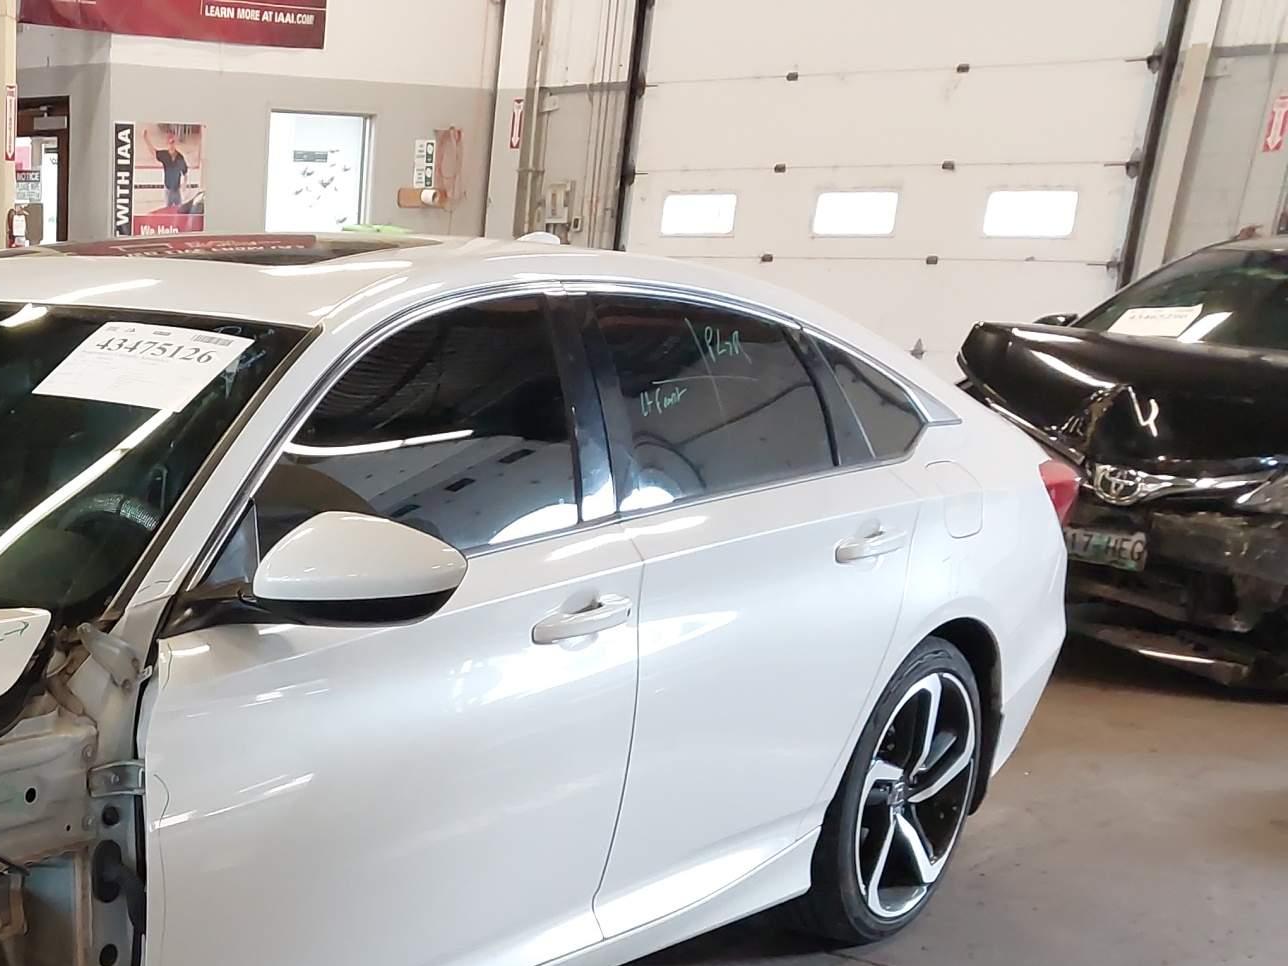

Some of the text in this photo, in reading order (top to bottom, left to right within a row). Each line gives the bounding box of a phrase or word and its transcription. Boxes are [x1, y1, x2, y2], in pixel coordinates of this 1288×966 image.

[204, 5, 235, 19] LEARN
[236, 8, 260, 21] MORE
[262, 11, 273, 23] AT
[117, 129, 131, 164] IAA
[116, 171, 130, 225] WITH
[140, 225, 155, 235] We
[96, 337, 216, 364] 43475126
[1104, 536, 1145, 561] HEG
